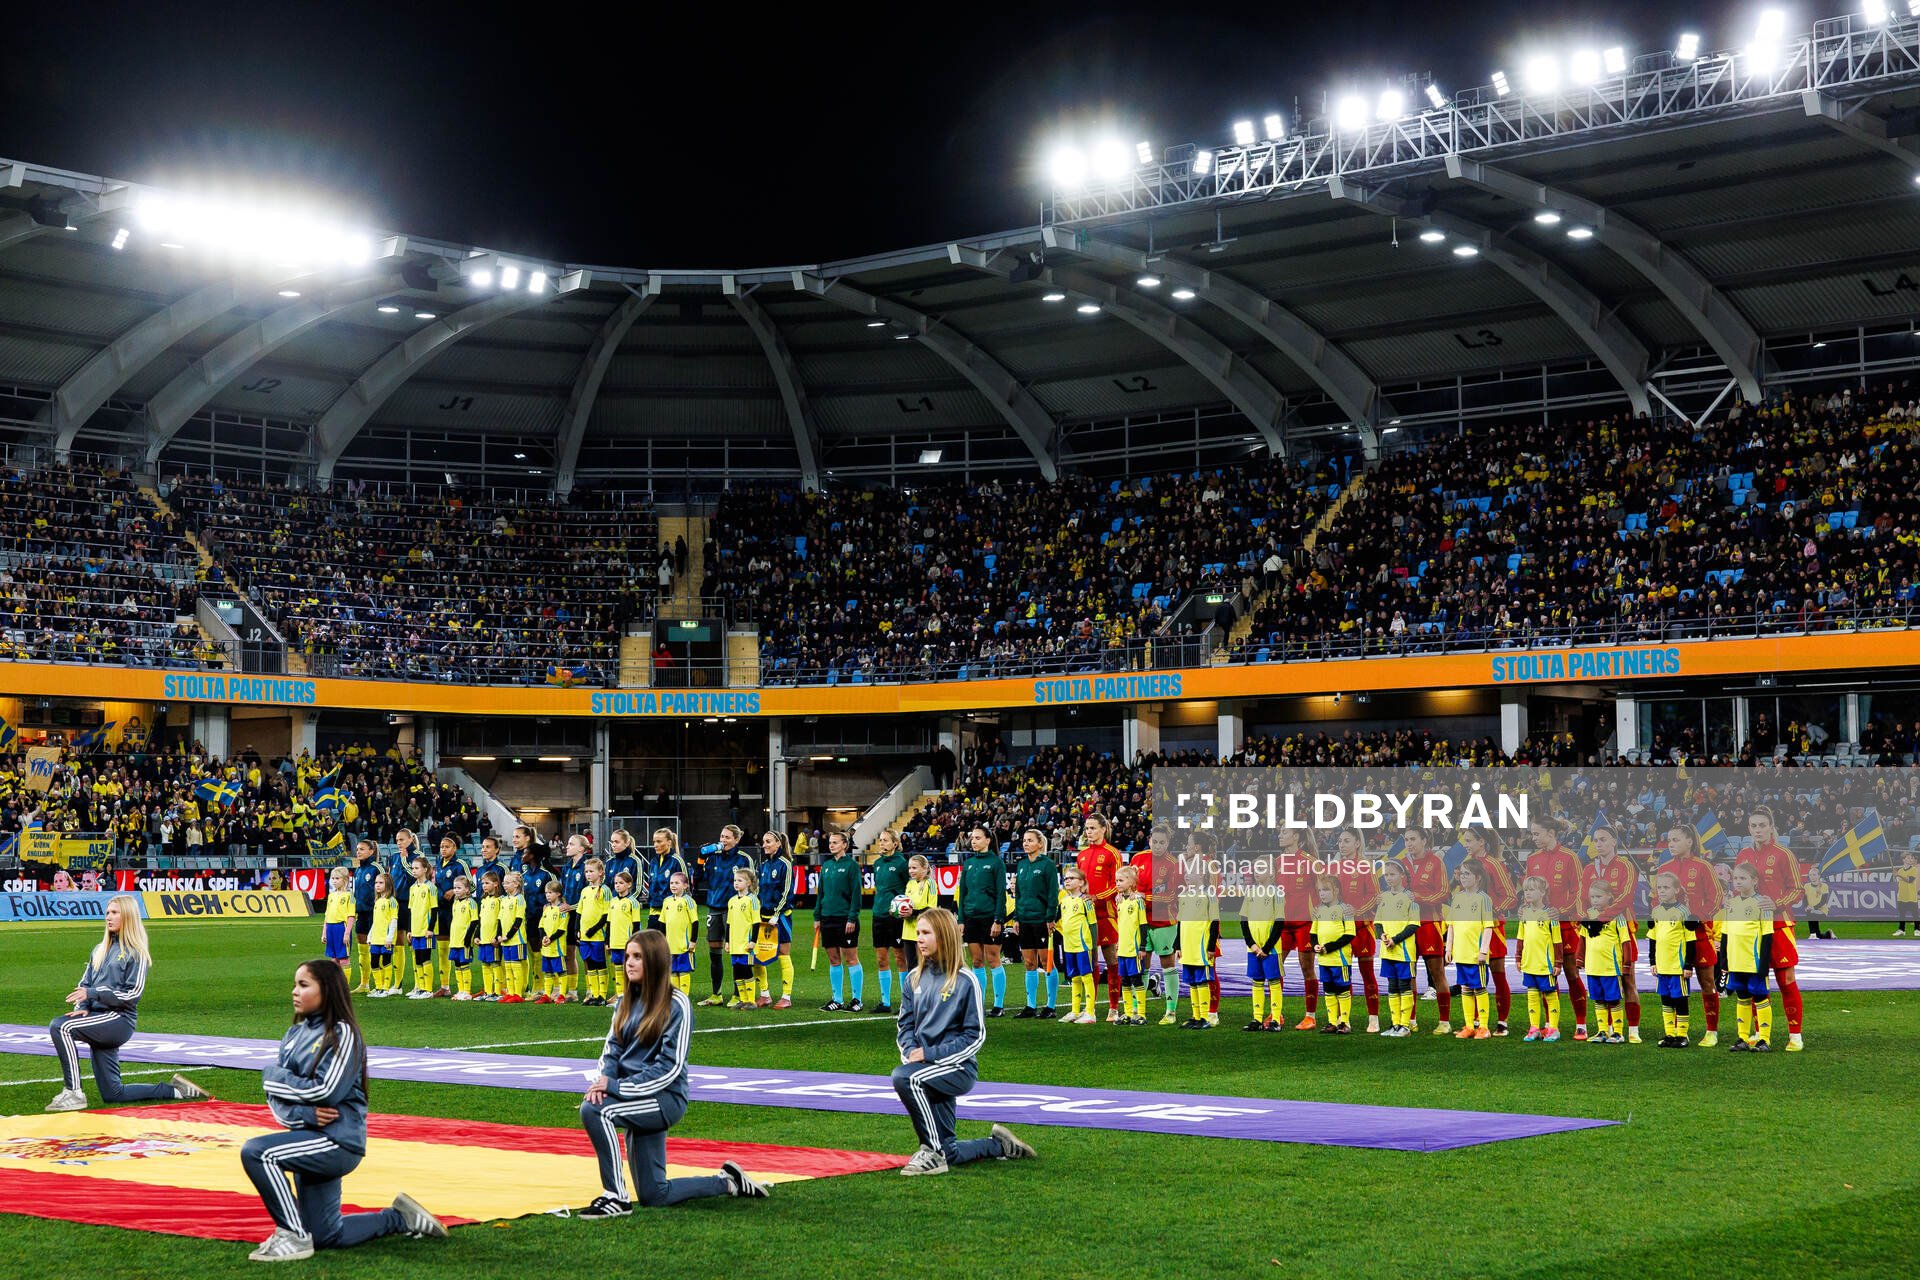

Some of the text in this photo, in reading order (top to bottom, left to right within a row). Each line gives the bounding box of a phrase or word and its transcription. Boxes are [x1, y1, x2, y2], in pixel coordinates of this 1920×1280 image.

[1453, 329, 1502, 350] L3
[242, 377, 282, 394] J2
[1112, 375, 1158, 393] L2
[896, 396, 935, 413] L1
[1491, 647, 1681, 682] STOLTA PARTNERS
[164, 674, 316, 704] STOLTA PARTNERS
[1034, 673, 1183, 704] STOLTA PARTNERS
[591, 692, 761, 714] STOLTA PARTNERS
[138, 877, 203, 892] SVENSKA
[8, 895, 104, 917] Folksam
[1827, 889, 1897, 909] ATION
